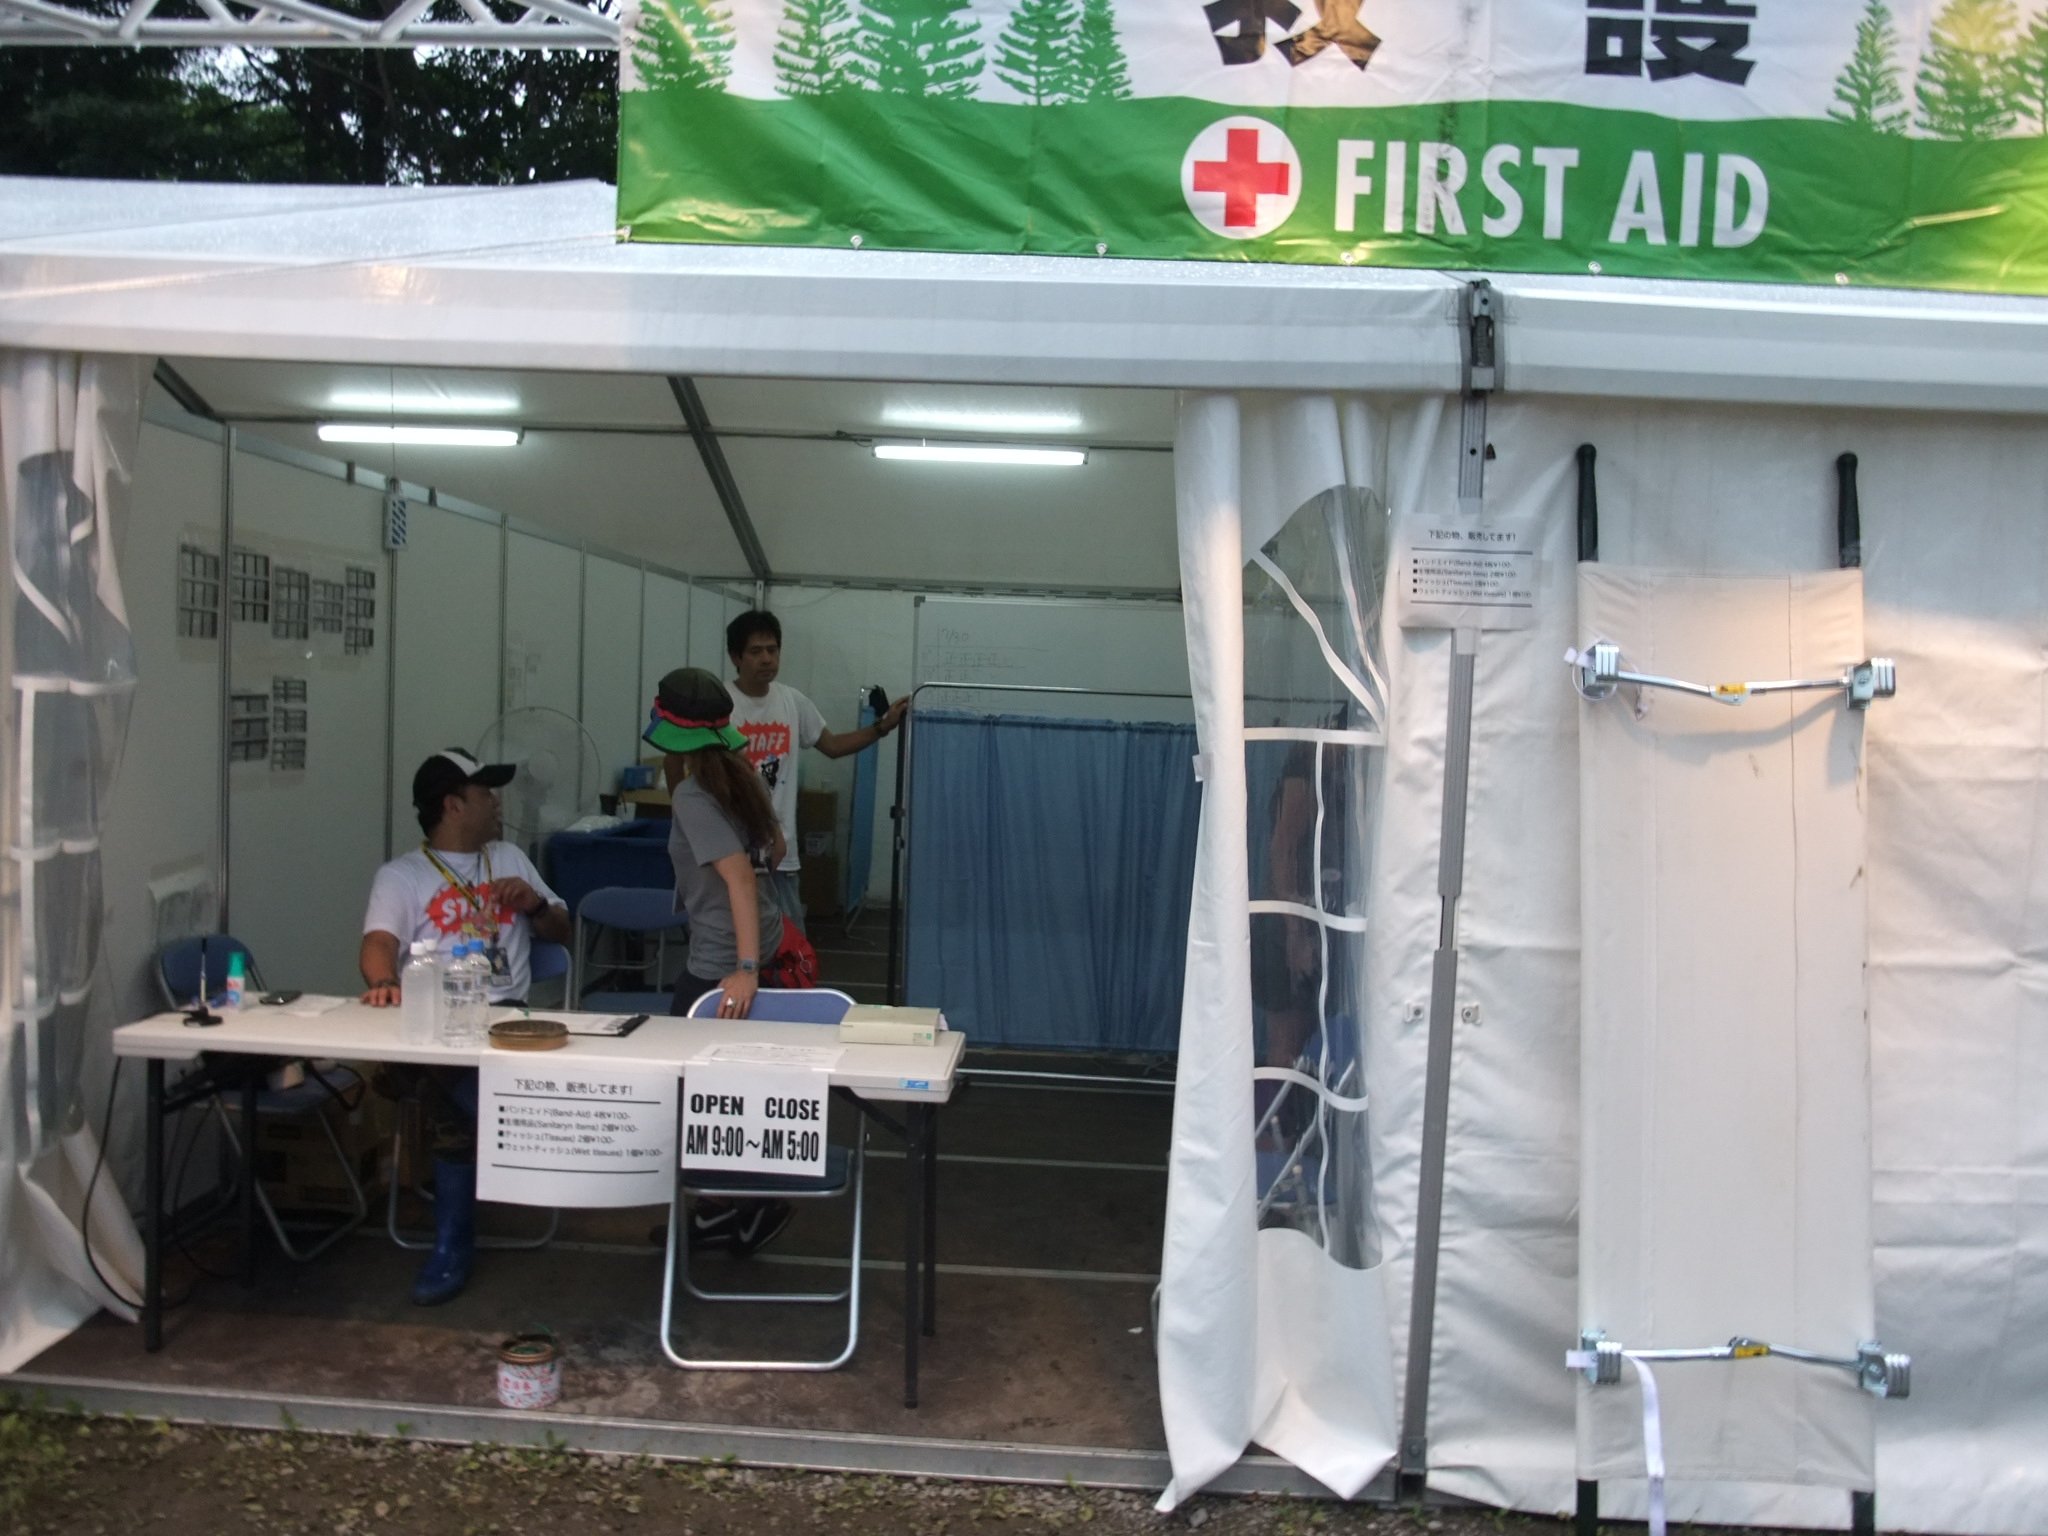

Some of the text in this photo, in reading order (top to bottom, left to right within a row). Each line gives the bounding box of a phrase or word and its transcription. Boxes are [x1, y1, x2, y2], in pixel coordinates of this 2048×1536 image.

[1333, 138, 1770, 249] FIRST AID
[744, 731, 787, 753] TAFF
[690, 1093, 820, 1121] OPEN CLOSE
[686, 1124, 709, 1155] AM
[787, 1131, 820, 1162] 5:00
